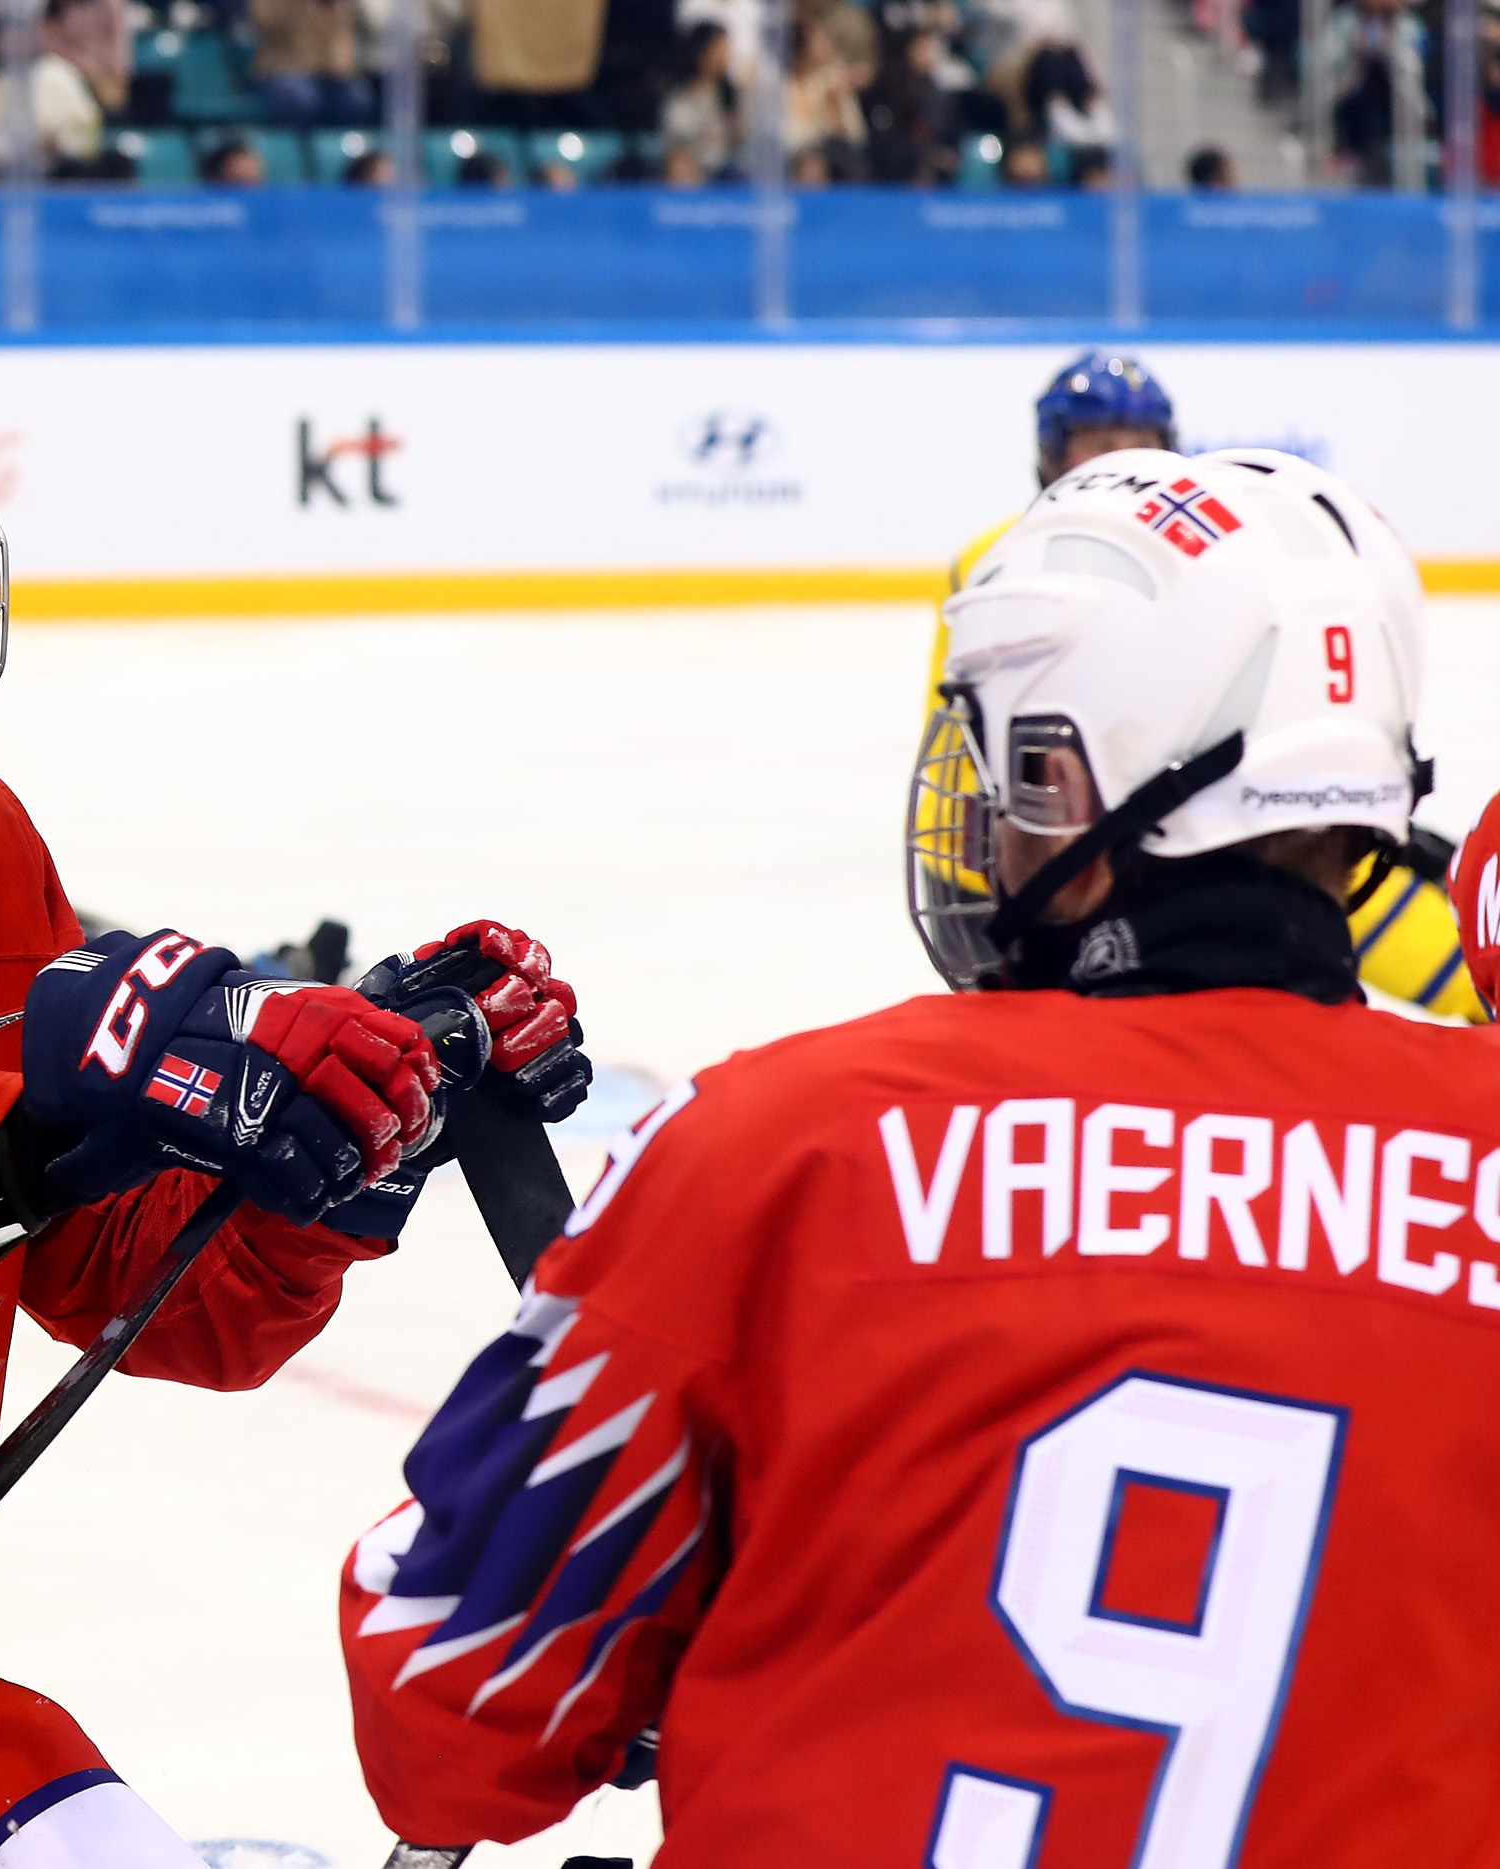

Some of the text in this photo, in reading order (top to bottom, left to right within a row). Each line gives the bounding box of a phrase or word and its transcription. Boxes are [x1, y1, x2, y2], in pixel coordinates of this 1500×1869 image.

[295, 411, 405, 509] kt
[1325, 626, 1353, 703] 9
[79, 933, 204, 1081] CC
[922, 1367, 1351, 1869] 9
